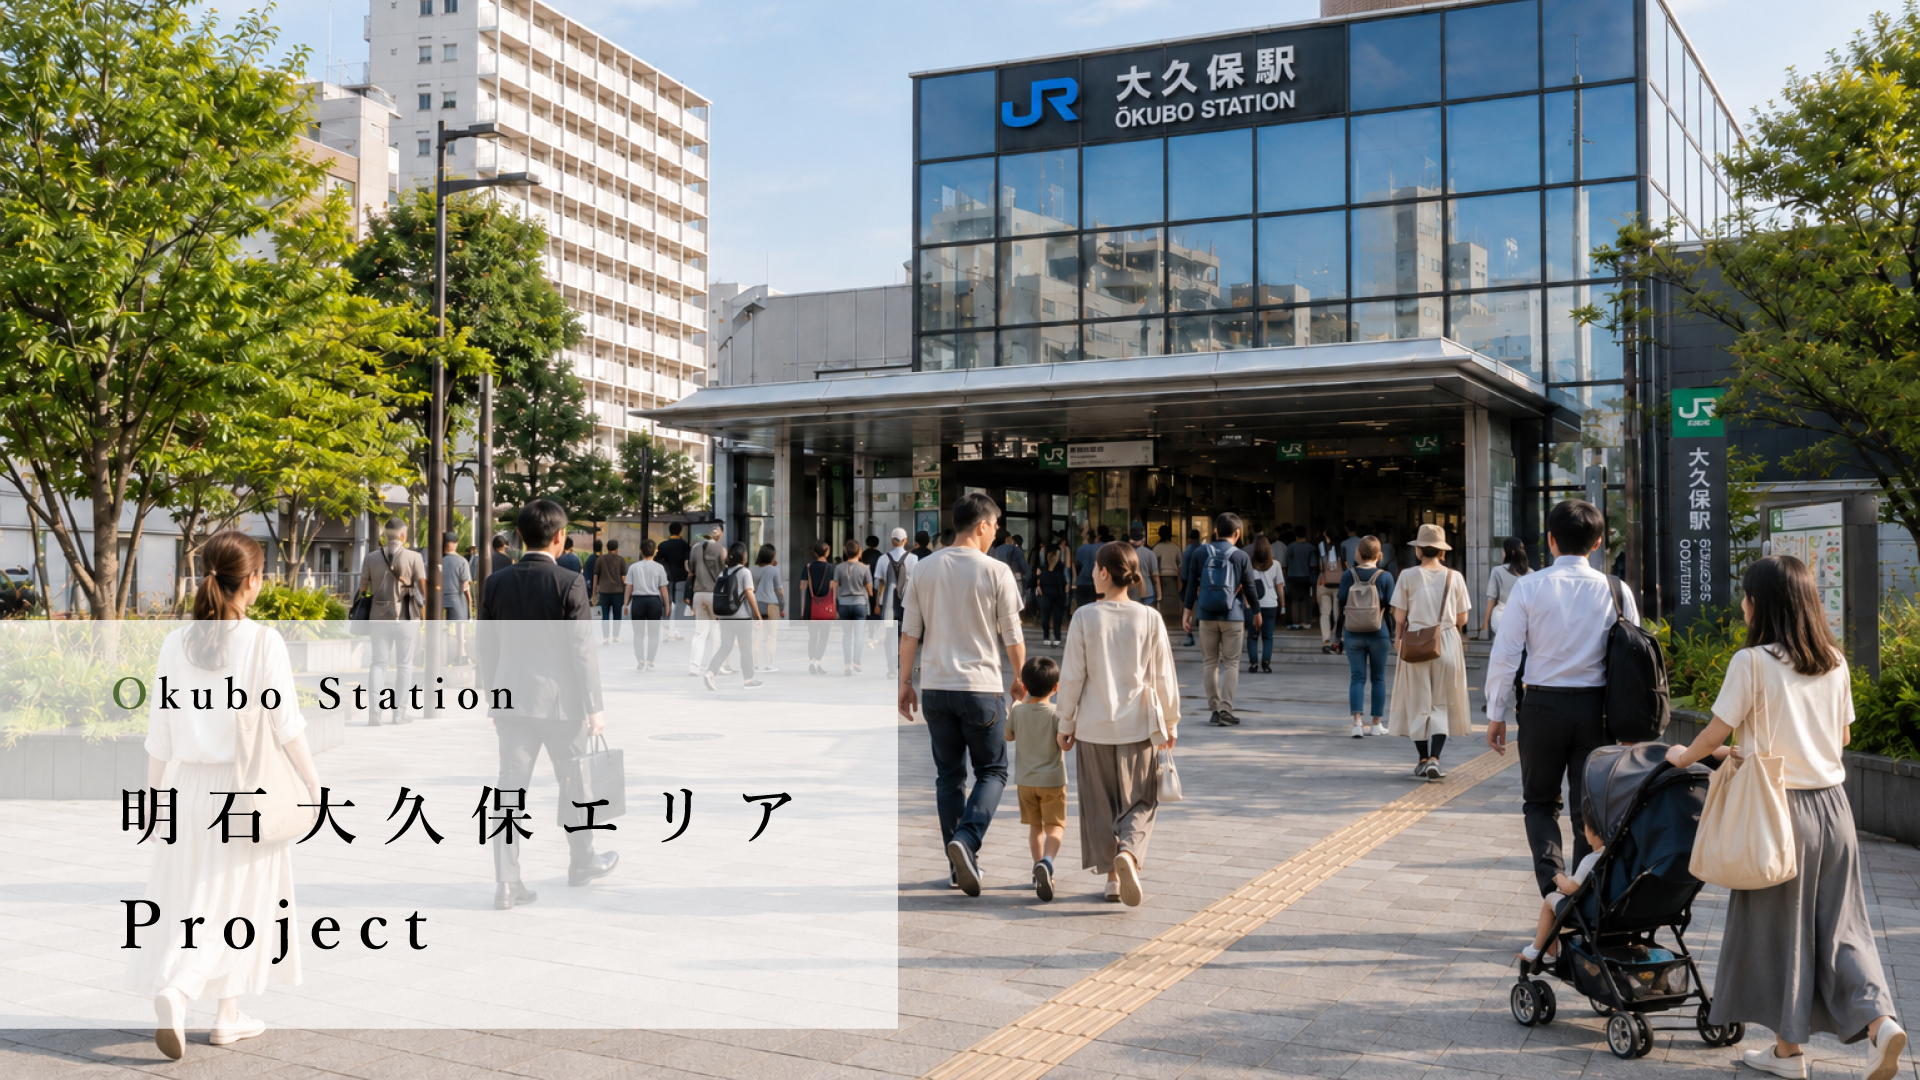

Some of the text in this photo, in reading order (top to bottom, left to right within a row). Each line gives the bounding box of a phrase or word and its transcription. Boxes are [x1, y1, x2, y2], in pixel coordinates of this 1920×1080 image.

[1116, 45, 1296, 103] 大久保駅
[1002, 77, 1078, 128] JR
[1115, 90, 1296, 128] ŌKUBO STATION
[1044, 447, 1064, 461] JR
[1689, 446, 1711, 531] 大久保駅
